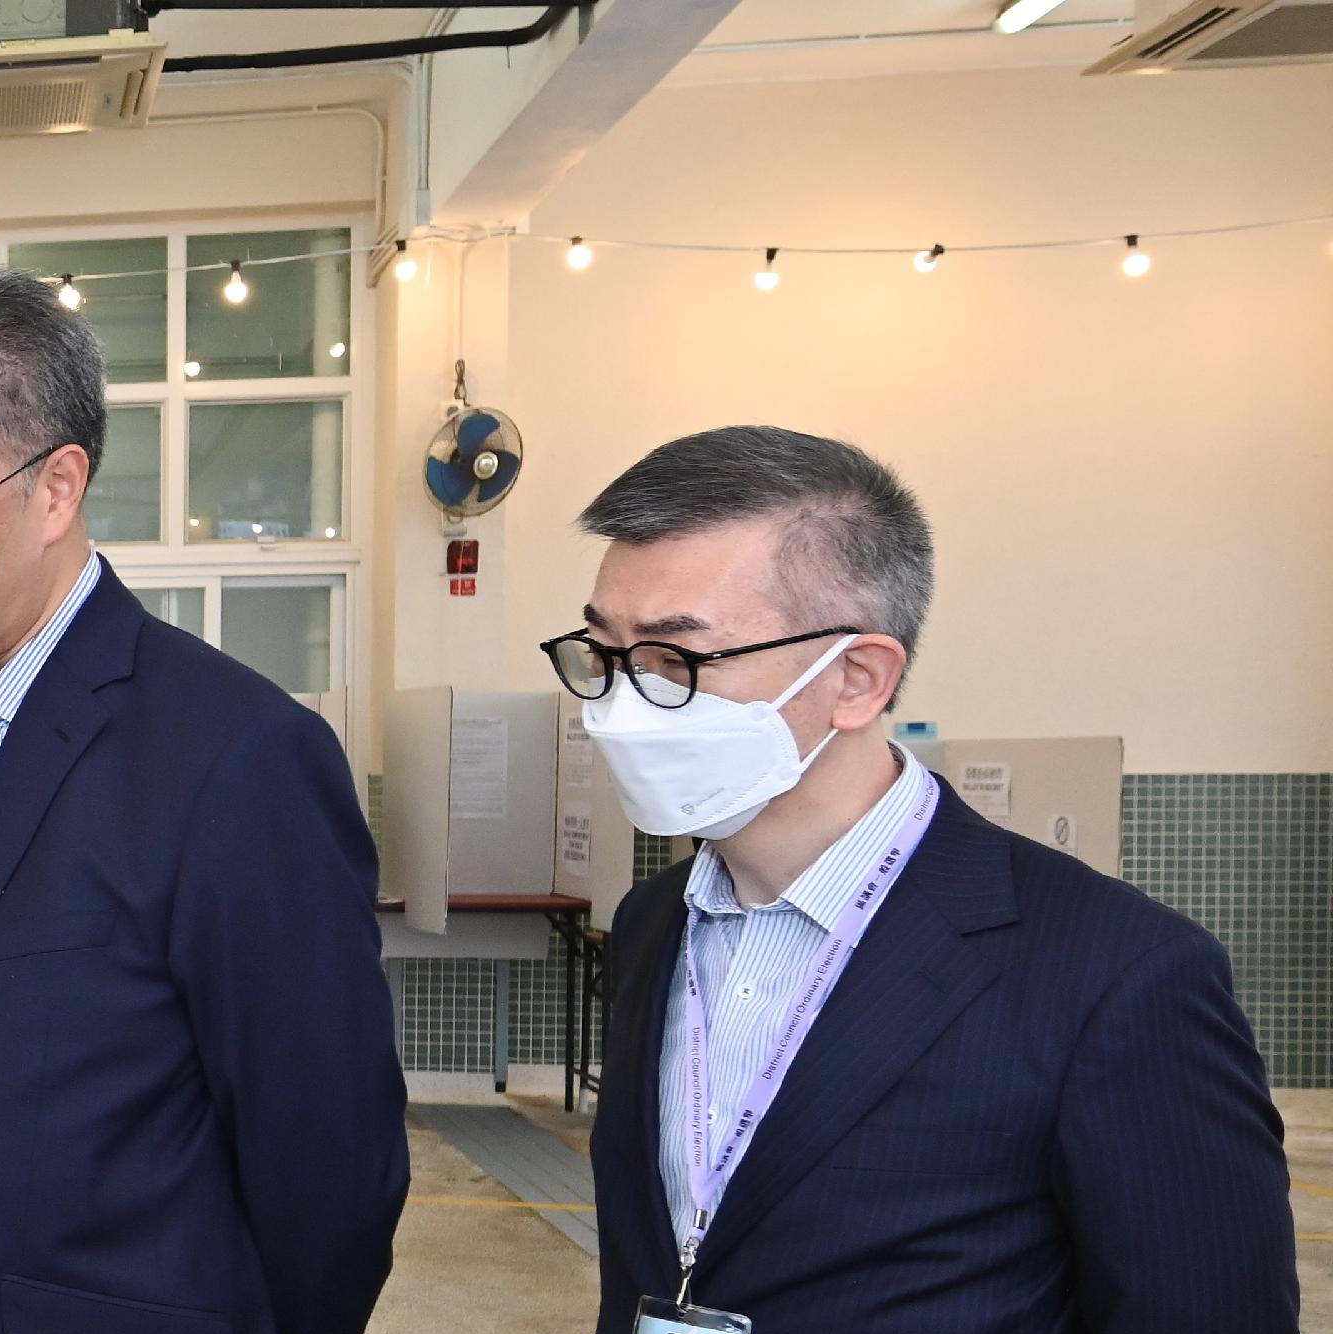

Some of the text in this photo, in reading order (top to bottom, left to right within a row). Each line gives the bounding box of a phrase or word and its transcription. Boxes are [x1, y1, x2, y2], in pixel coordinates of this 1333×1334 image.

[762, 938, 843, 1080] District Council Ordinary Election
